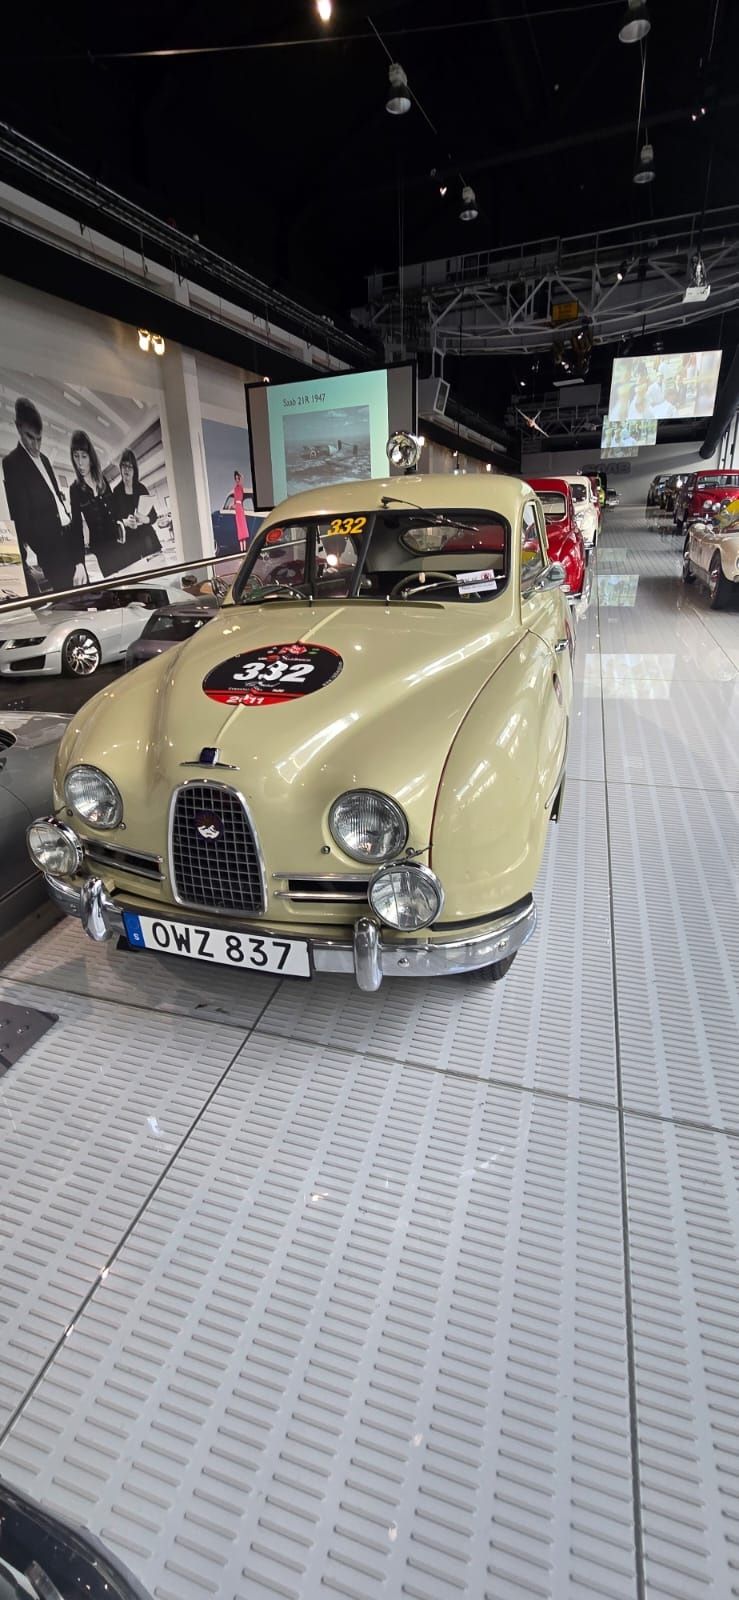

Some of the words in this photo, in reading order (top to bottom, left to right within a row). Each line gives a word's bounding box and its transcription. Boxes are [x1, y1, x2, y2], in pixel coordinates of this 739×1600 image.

[283, 397, 296, 407] Saab
[298, 395, 310, 406] 21R
[311, 393, 326, 403] 1947
[328, 517, 367, 537] 332
[233, 660, 315, 683] 332
[133, 932, 140, 941] S
[152, 922, 214, 958] OWZ
[225, 935, 291, 970] 837
